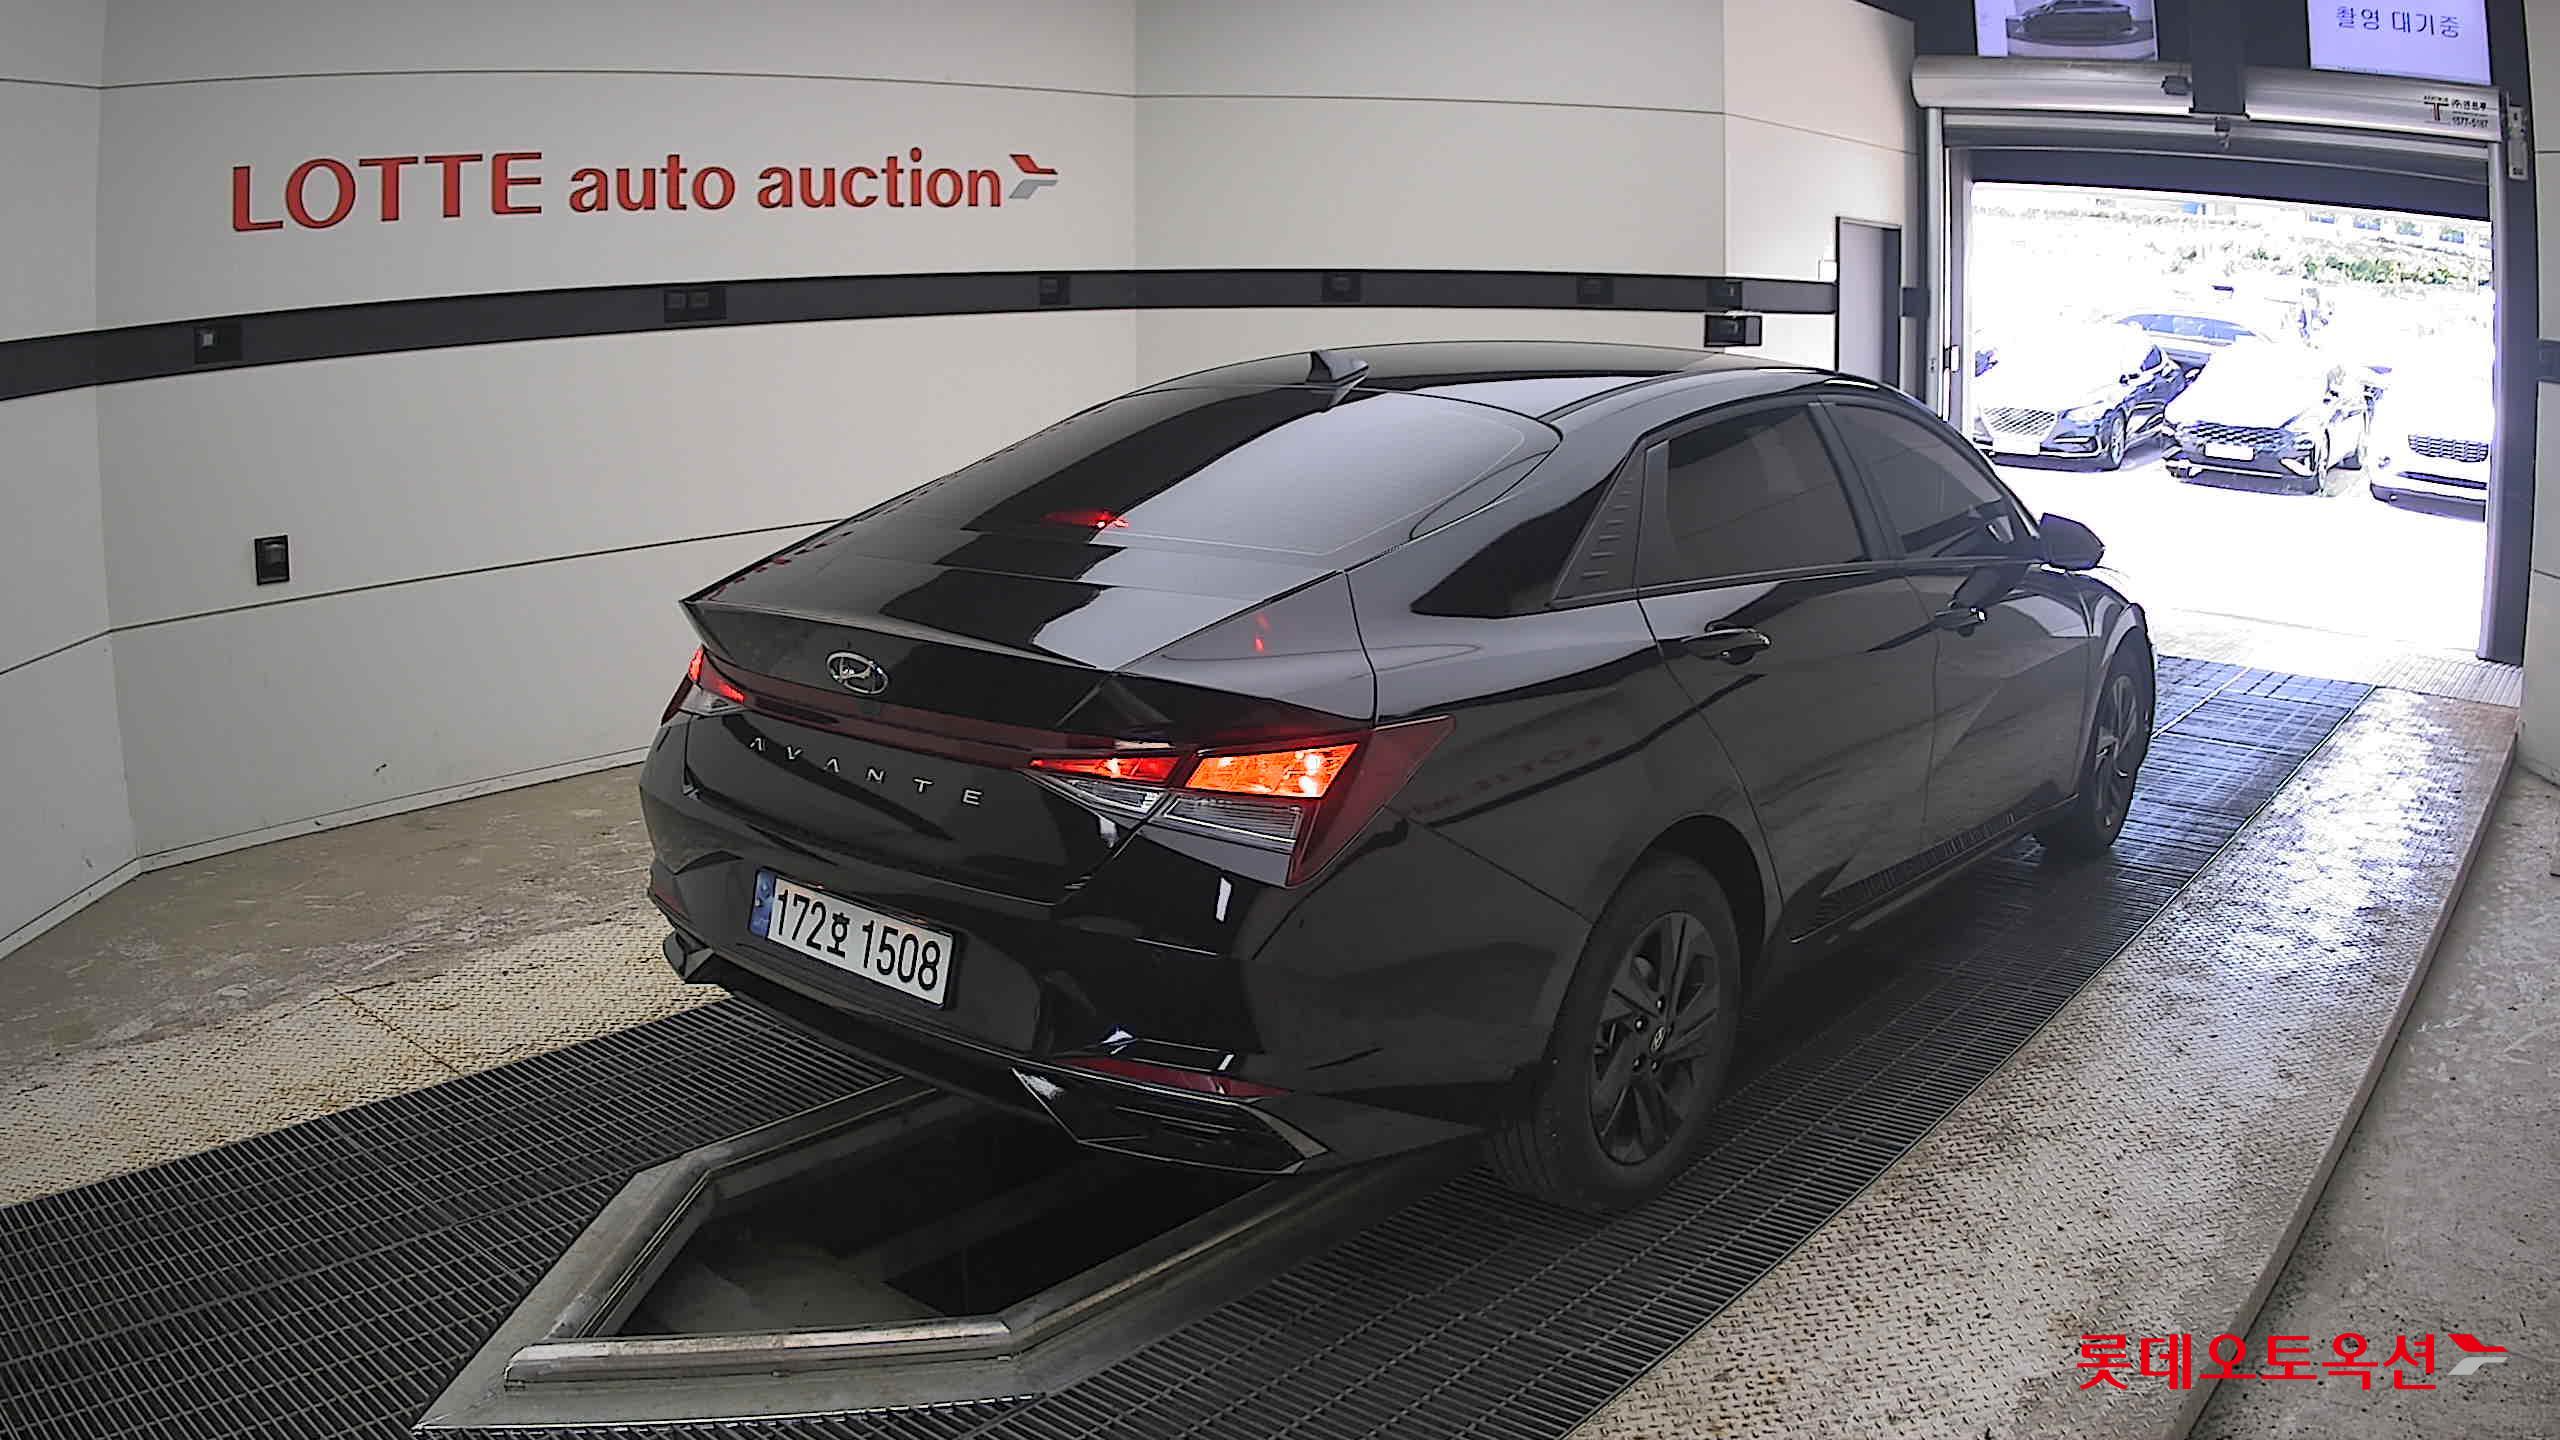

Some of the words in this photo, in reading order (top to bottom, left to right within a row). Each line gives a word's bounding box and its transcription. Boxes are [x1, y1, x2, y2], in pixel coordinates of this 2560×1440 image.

[2337, 7, 2379, 30] 촬영
[2392, 10, 2459, 38] 대기중
[232, 151, 542, 232] LOTTE
[568, 154, 736, 212] auto
[757, 147, 1001, 208] auction
[750, 737, 983, 806] AVANTE
[862, 919, 942, 992] 1508
